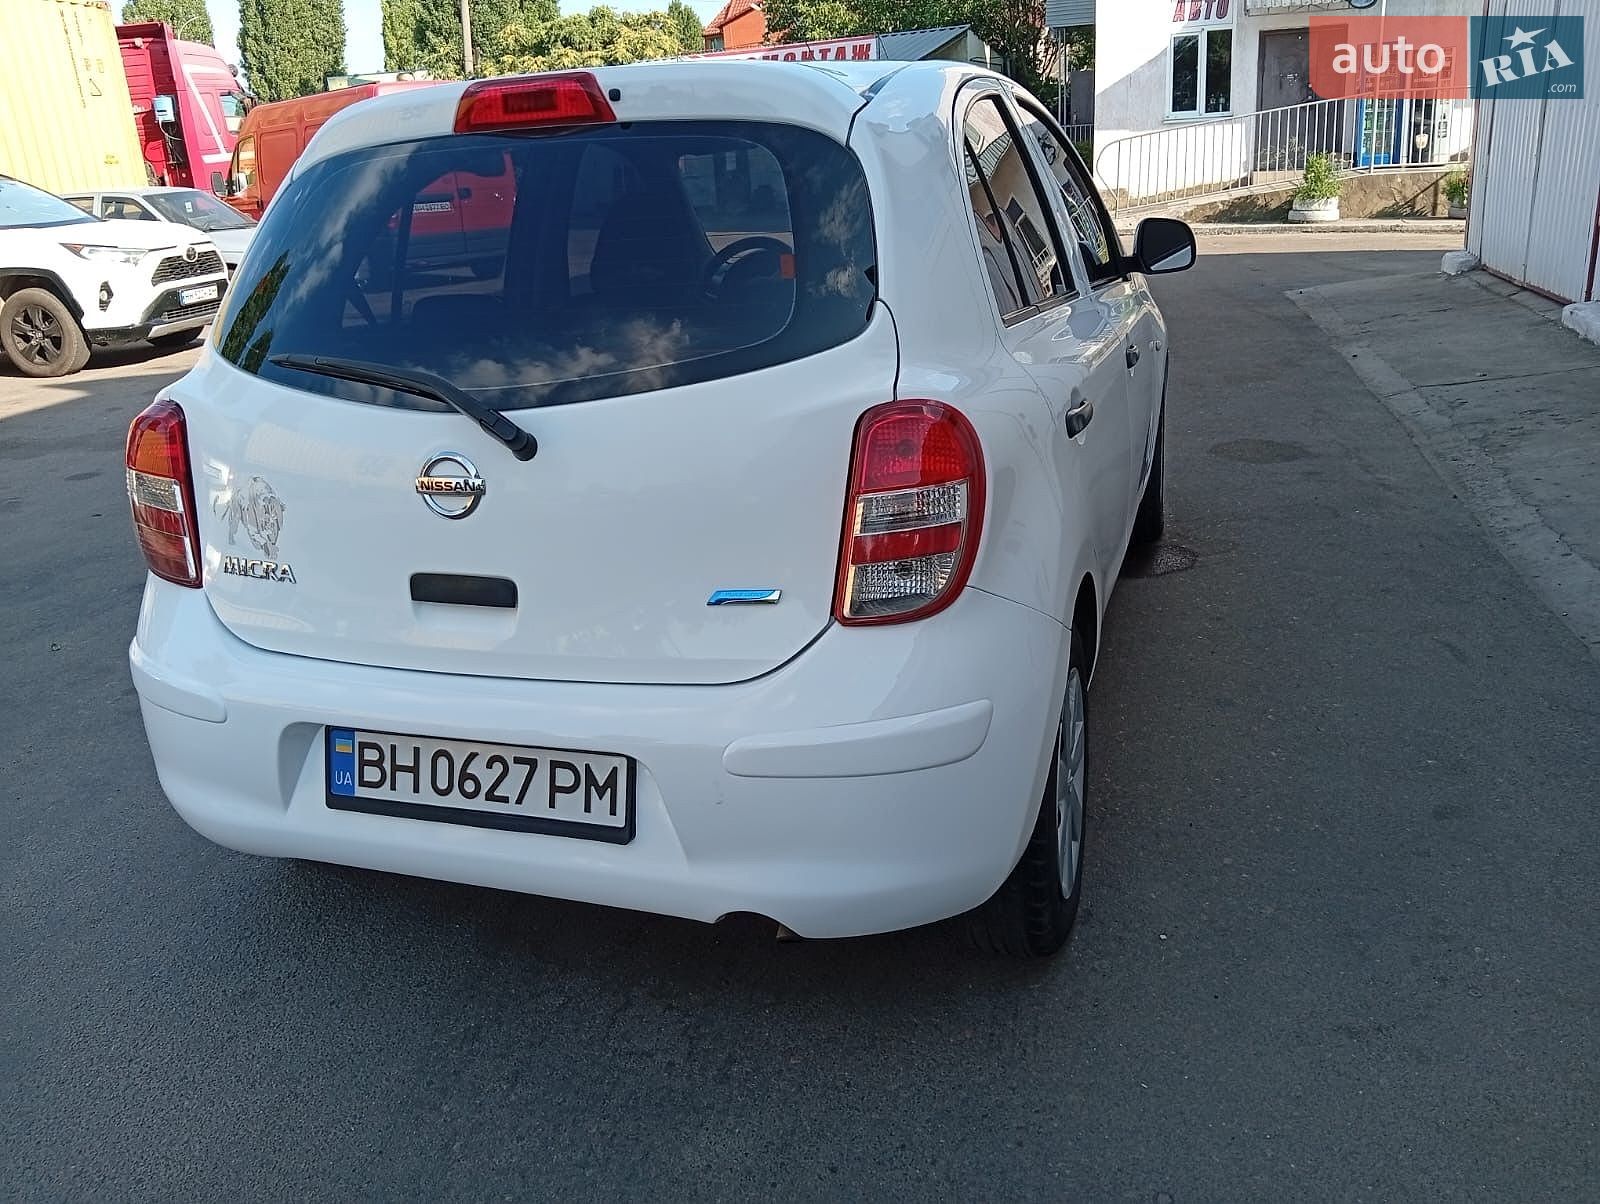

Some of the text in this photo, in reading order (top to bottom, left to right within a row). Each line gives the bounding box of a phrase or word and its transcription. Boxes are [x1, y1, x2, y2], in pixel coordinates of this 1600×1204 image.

[420, 479, 477, 492] NISSAN
[224, 555, 297, 584] MICRA
[334, 771, 353, 787] UA
